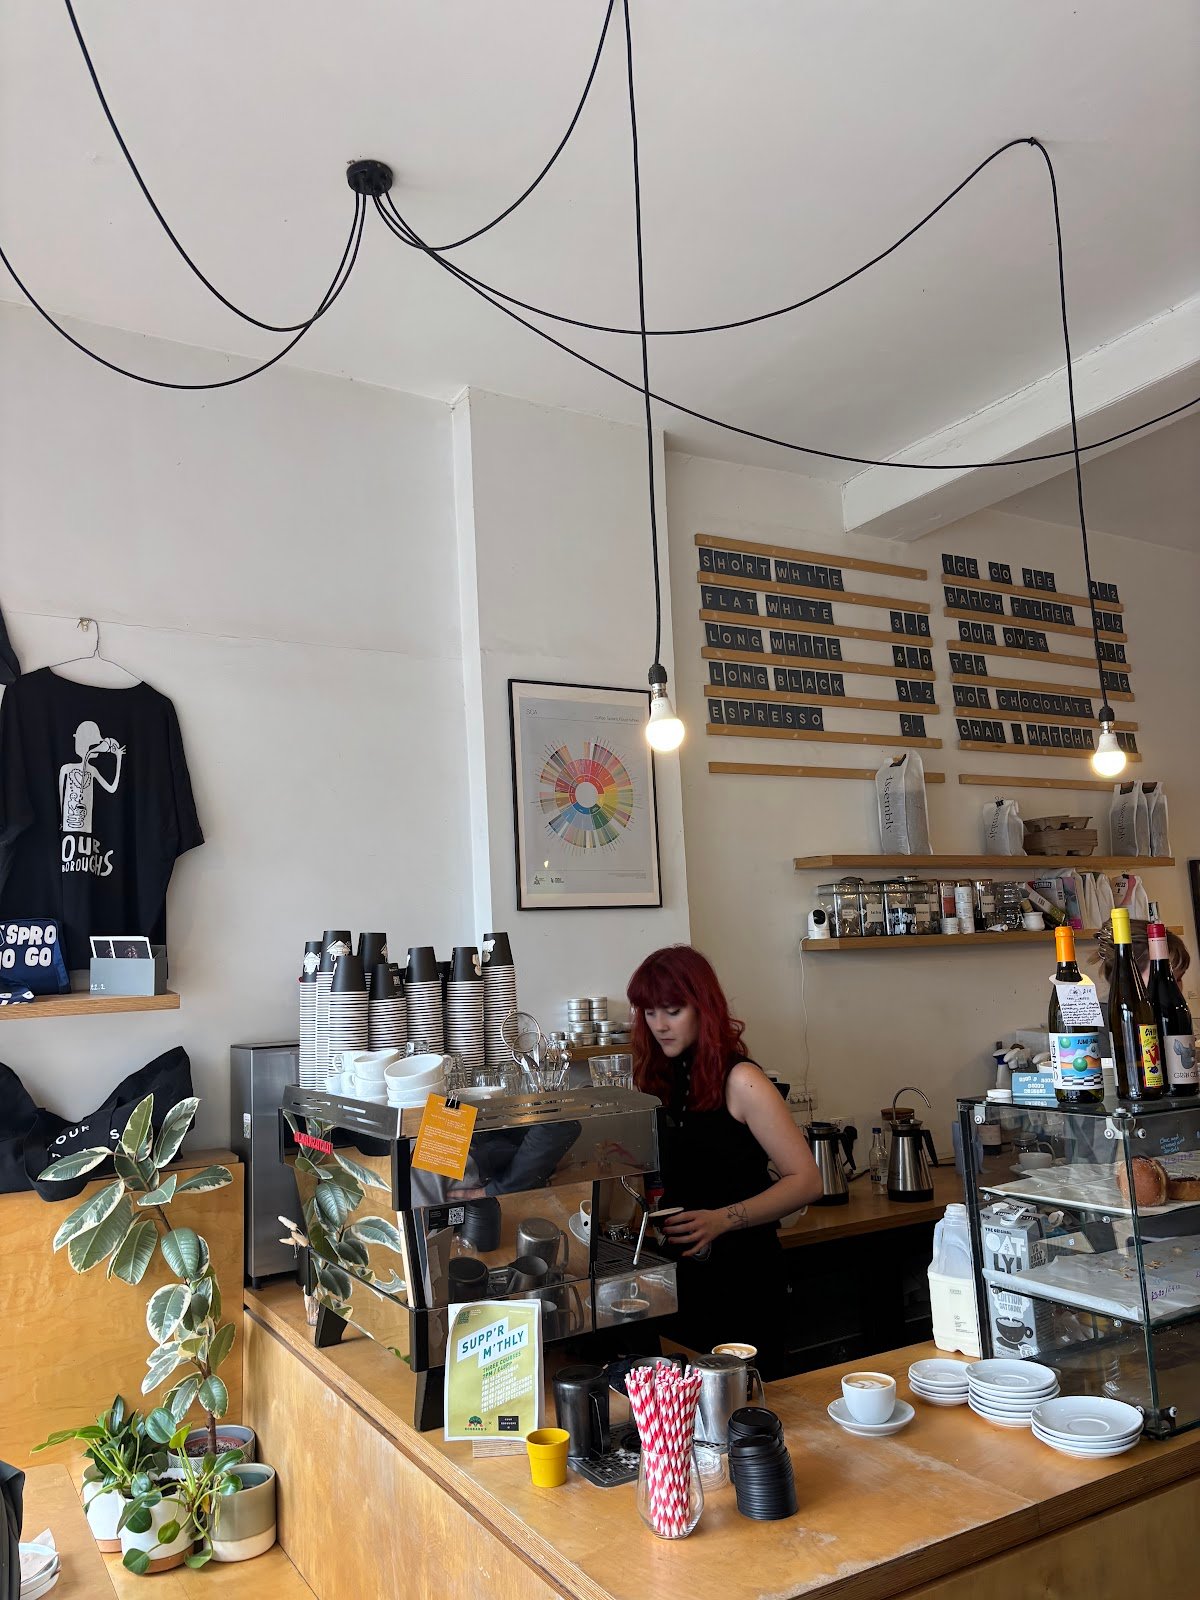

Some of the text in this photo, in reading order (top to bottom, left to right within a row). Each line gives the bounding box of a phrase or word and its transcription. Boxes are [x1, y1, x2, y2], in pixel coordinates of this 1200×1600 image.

[703, 555, 840, 586] SHORT WHITE
[946, 560, 976, 574] ICE
[1091, 587, 1116, 598] 4.2
[705, 593, 830, 619] FLAT WHITE
[948, 593, 1071, 621] BATCH FILTER
[894, 618, 927, 632] 3.8
[1096, 617, 1121, 630] 3.2
[709, 630, 838, 655] LONG WHITE
[961, 627, 1045, 648] OUR OVER
[896, 652, 929, 665] 4.0
[953, 659, 984, 671] TEA
[713, 668, 841, 692] LONG BLACK
[1103, 678, 1128, 688] 2.2
[900, 686, 931, 699] 3.2
[956, 692, 1090, 713] HOT CHOCOLATE
[712, 707, 820, 726] ESPRESSO
[961, 725, 1002, 738] CHAI
[1029, 730, 1092, 745] MATCHA
[62, 835, 100, 862] OUR
[62, 850, 114, 876] BOROUGHS
[25, 947, 51, 967] GO
[986, 1233, 1026, 1257] OAT
[462, 1325, 504, 1354] SUPP'R
[483, 1331, 524, 1359] M'THLY
[483, 1351, 521, 1373] THREE COURSES
